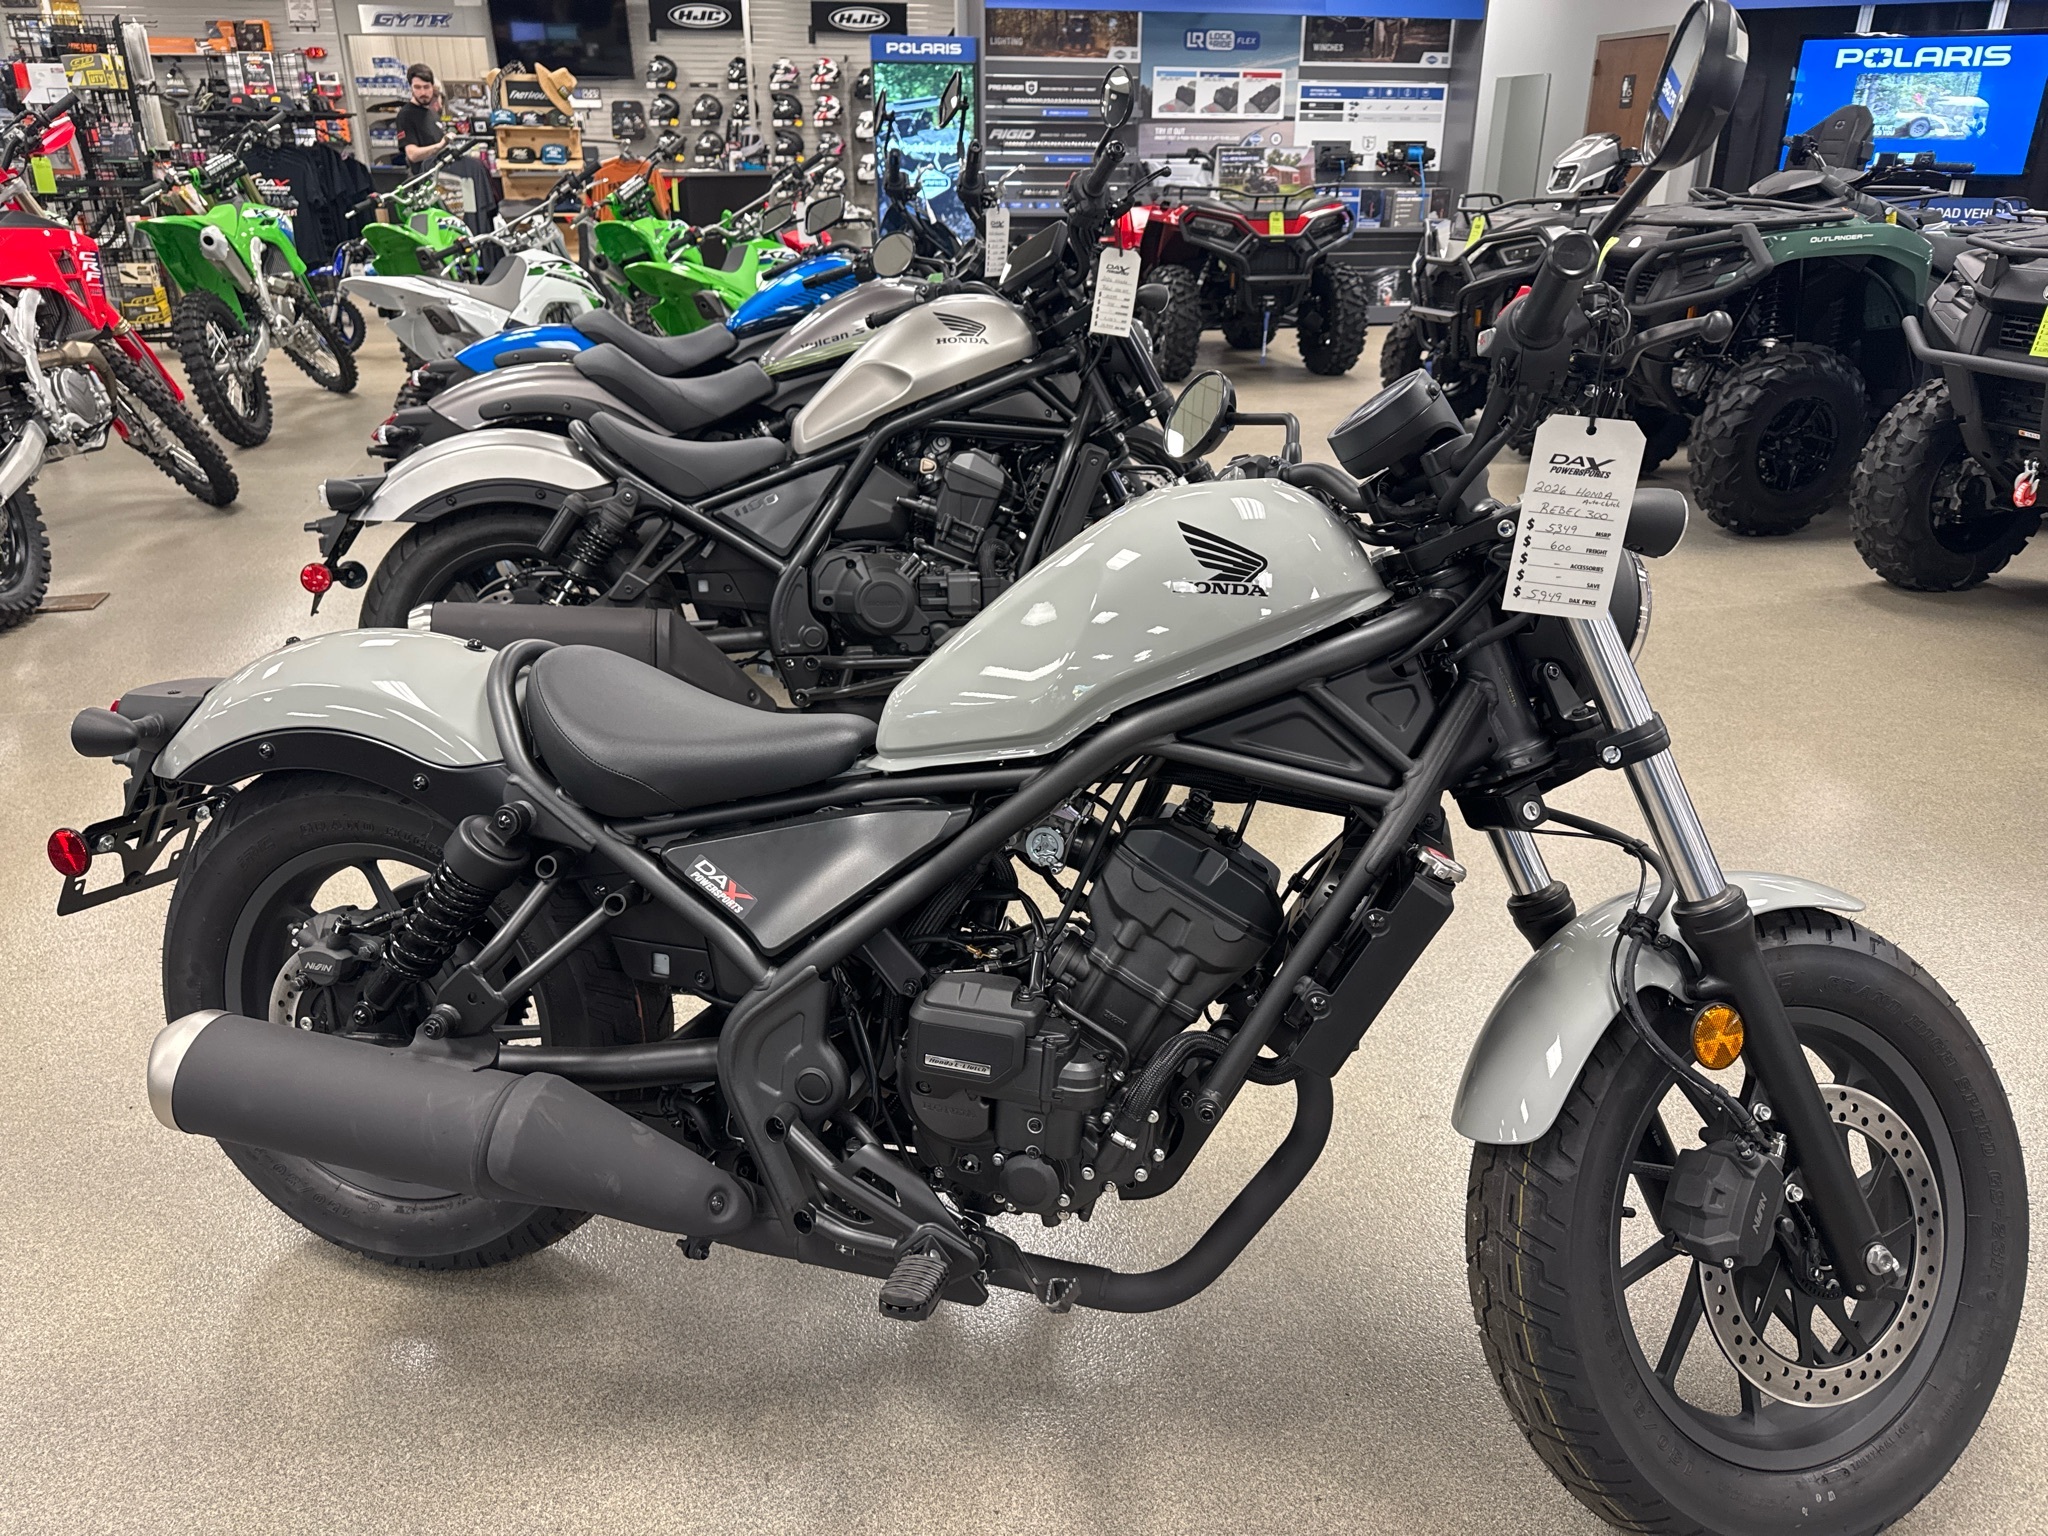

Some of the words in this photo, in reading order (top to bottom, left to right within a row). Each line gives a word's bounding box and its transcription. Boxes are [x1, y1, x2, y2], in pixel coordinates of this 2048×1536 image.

[371, 12, 453, 28] GYTR
[678, 10, 722, 22] HJC
[838, 13, 881, 24] HJC
[989, 37, 1023, 46] LIGHTING
[1208, 32, 1232, 40] LOCK
[1237, 37, 1257, 45] FLEX
[885, 42, 962, 55] POLARIS
[1312, 43, 1344, 52] WINCHES
[1835, 45, 2012, 69] POLARIS
[988, 129, 1036, 140] RIGID
[255, 178, 291, 187] DAX
[1810, 233, 1863, 244] OUTLANDER
[1106, 263, 1131, 274] DAX
[935, 336, 989, 346] HONDA
[1549, 453, 1617, 474] DAX
[1549, 465, 1612, 479] POWERSPORTS
[1533, 480, 1567, 495] 2026
[1575, 487, 1613, 500] HONDA
[1539, 501, 1582, 517] REBEL
[1585, 510, 1610, 521] 300
[1526, 517, 1535, 531] $
[1522, 534, 1532, 548] $
[1550, 540, 1572, 552] 600
[1585, 547, 1608, 556] FREIGHT
[1519, 551, 1528, 565] $
[1570, 563, 1605, 573] ACCESSORIES
[1516, 568, 1525, 582] $
[1586, 582, 1600, 590] SAVE
[1512, 585, 1522, 598] $
[1568, 597, 1580, 605] DAX
[1581, 598, 1597, 607] PRICE
[694, 859, 754, 901] DAX
[690, 870, 744, 914] POWERSPORTS
[928, 1057, 954, 1067] Honda
